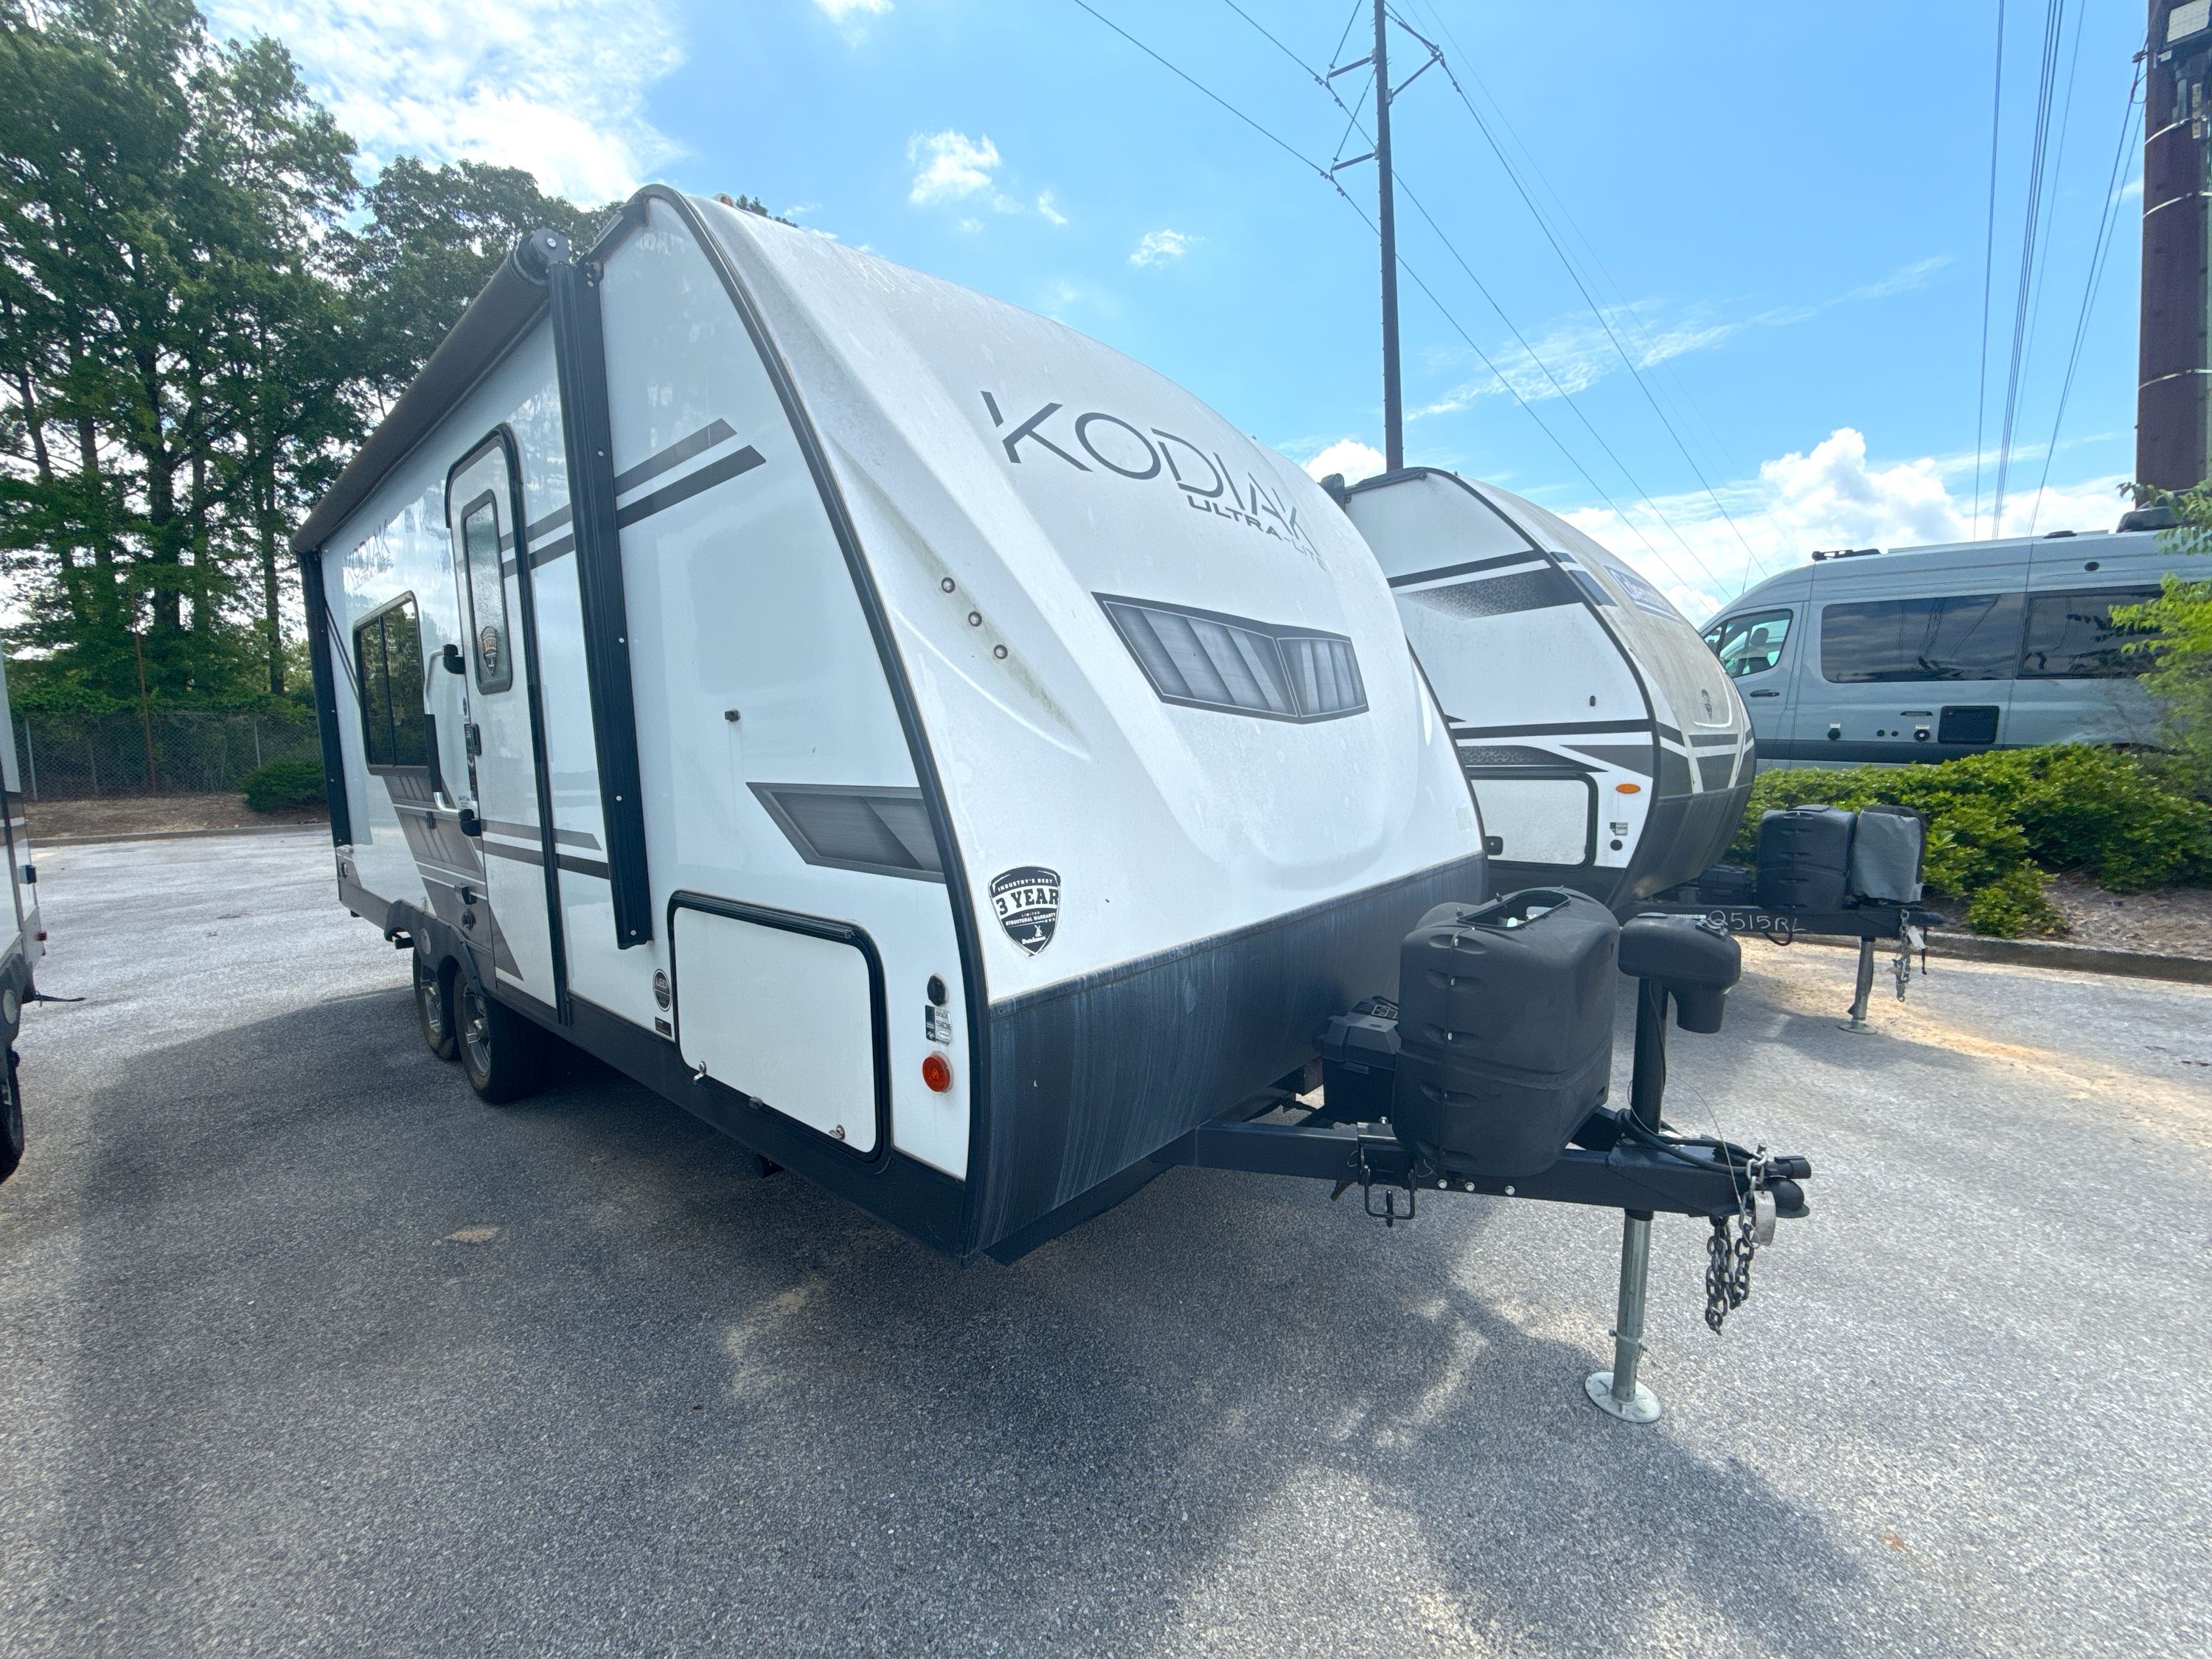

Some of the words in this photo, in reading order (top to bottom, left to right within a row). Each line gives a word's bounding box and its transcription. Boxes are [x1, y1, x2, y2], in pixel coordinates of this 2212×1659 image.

[981, 390, 1321, 557] KODIAK
[1187, 495, 1326, 571] ULTRA-LITE
[998, 878, 1035, 892] INDUSTRY'S
[995, 897, 1009, 915] 3
[1010, 888, 1059, 908] YEAR
[1005, 917, 1033, 926] STRUCTURAL
